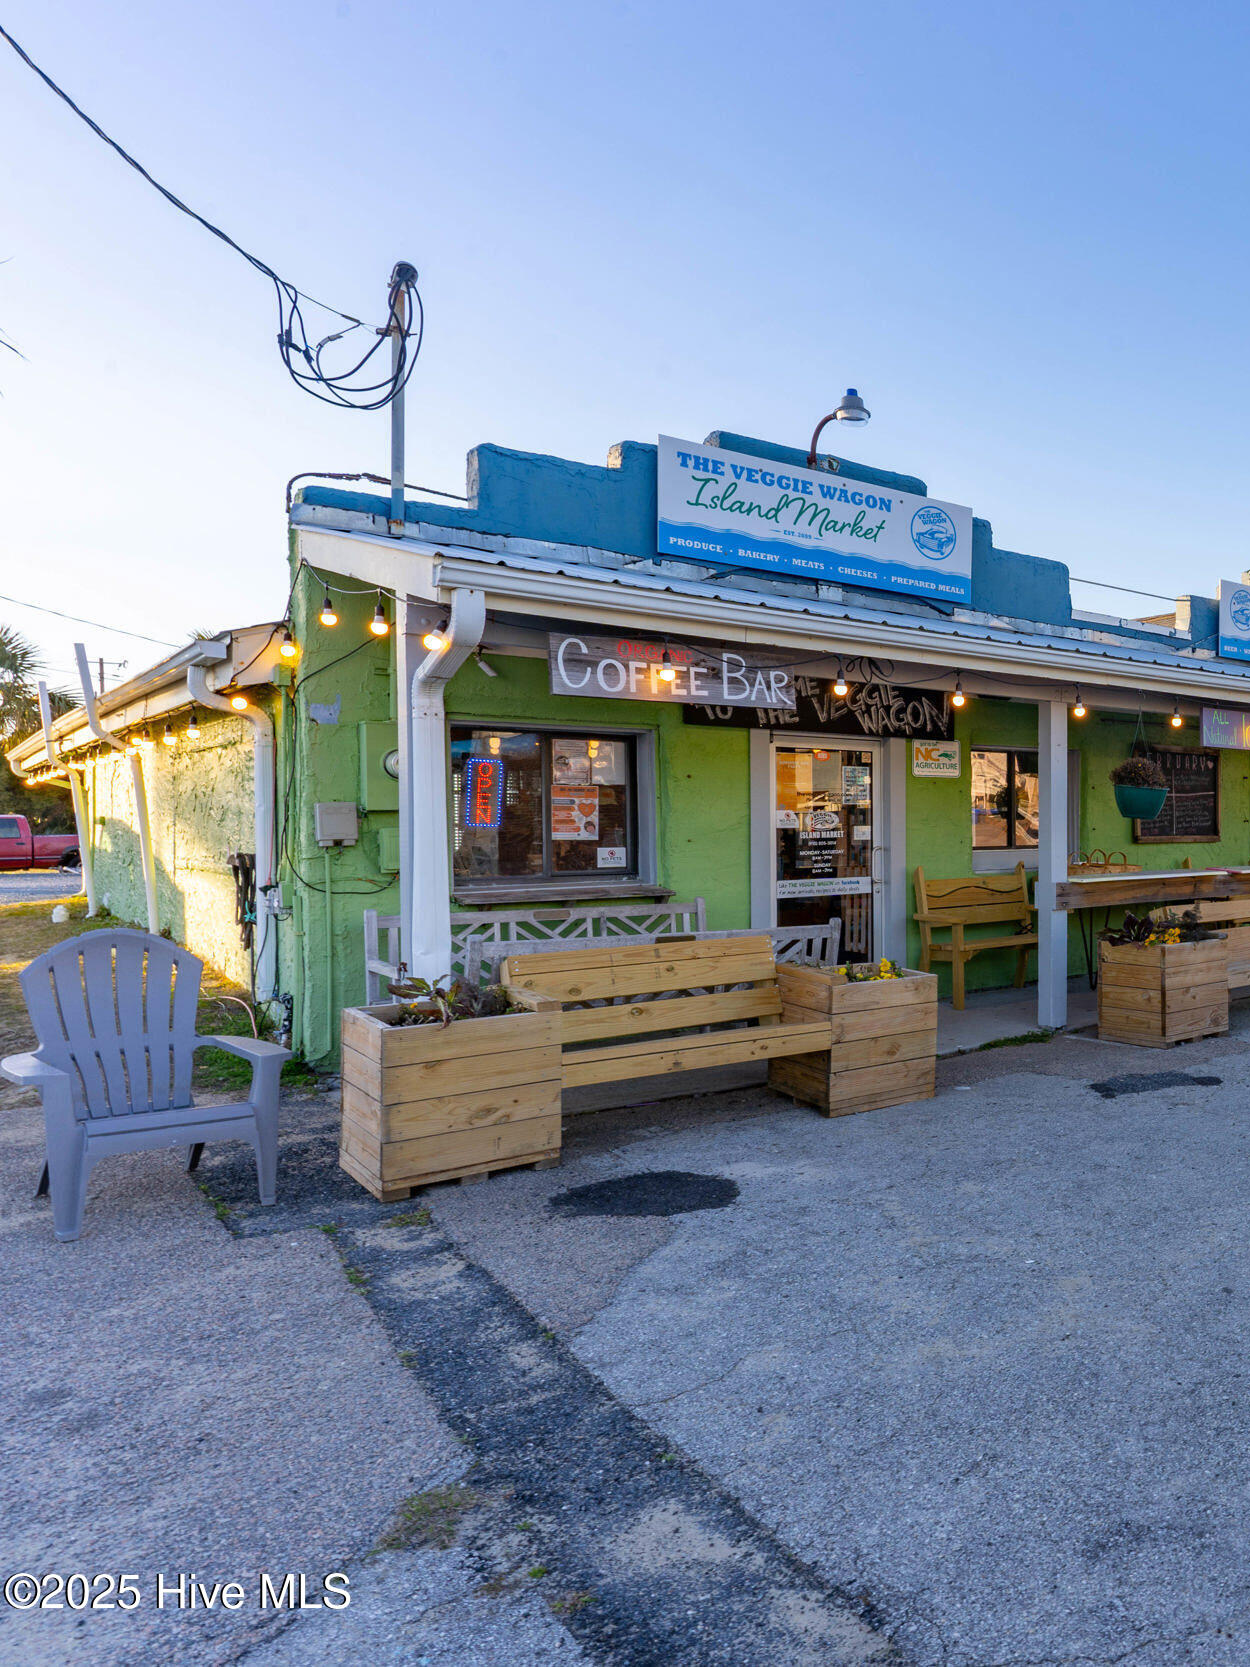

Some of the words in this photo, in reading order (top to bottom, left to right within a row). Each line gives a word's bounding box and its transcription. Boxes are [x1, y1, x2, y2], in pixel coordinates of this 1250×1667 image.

[677, 451, 726, 477] THE
[730, 465, 813, 497] VEGGIE
[818, 483, 893, 513] WAGON
[686, 475, 788, 525] Island
[786, 497, 886, 543] Market
[669, 536, 723, 553] PRODUCE
[738, 548, 780, 562] BAKERY
[792, 557, 825, 570] MEATS
[838, 566, 878, 580] CHEESES
[891, 575, 936, 590] PREPARED
[938, 583, 965, 595] MEALS
[558, 637, 709, 696] COFFEE
[722, 653, 794, 705] BAR
[811, 683, 901, 723] VEGGIE
[855, 692, 950, 739] WAGON
[915, 747, 940, 761] NC
[915, 761, 958, 770] AGRICULTURE
[1147, 752, 1206, 771] EBRUARY
[475, 762, 494, 824] OPEN
